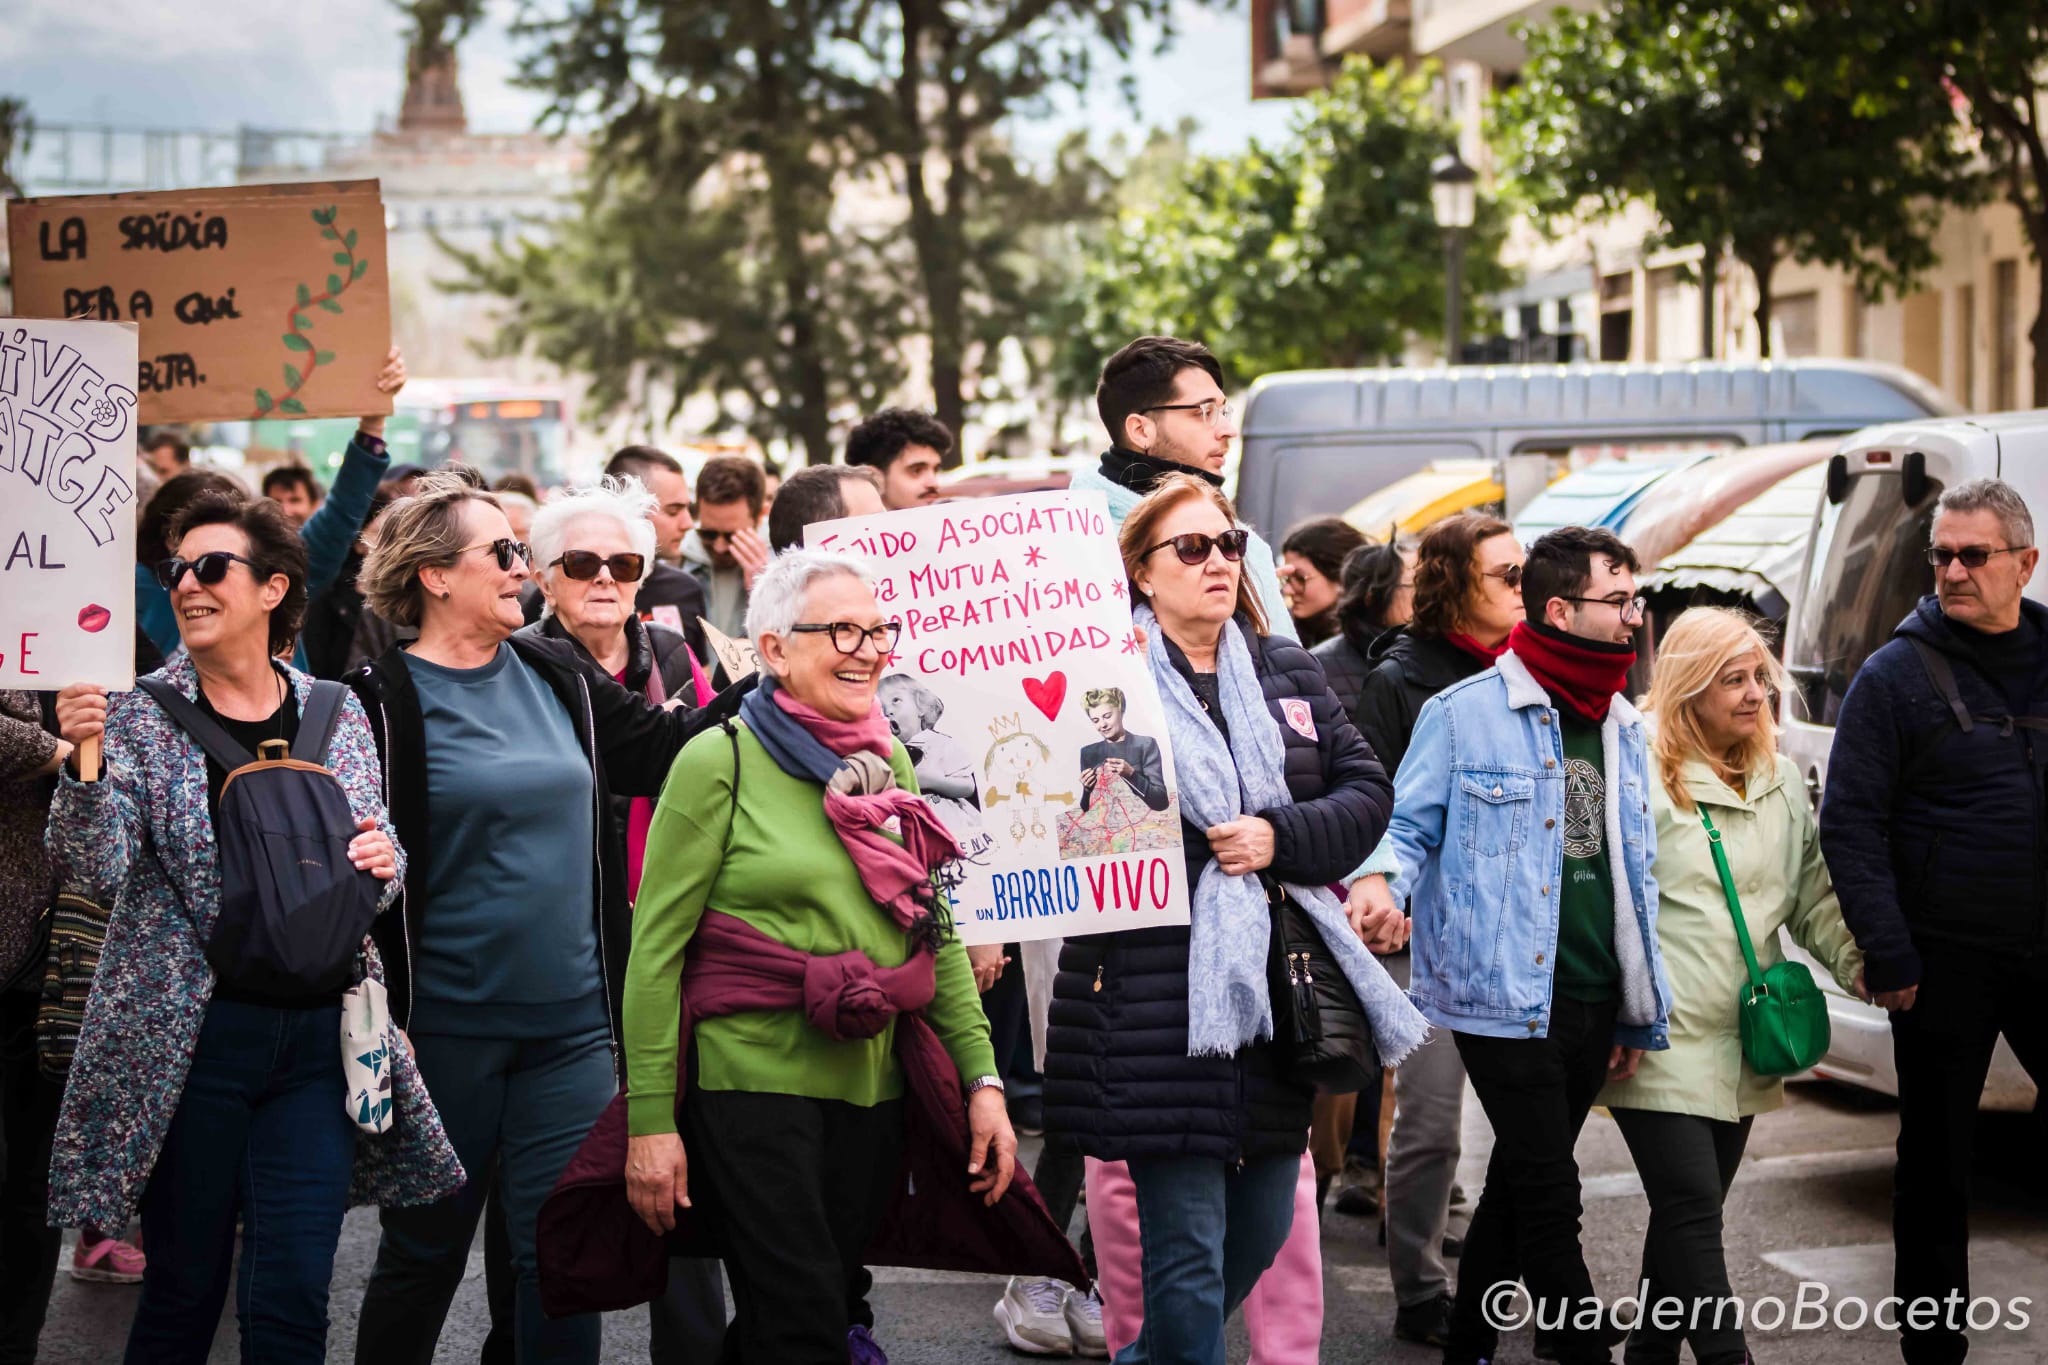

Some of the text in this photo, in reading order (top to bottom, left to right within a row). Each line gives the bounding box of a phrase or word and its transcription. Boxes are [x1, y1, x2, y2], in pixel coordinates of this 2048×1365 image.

[39, 217, 87, 260] LA
[130, 290, 153, 319] A
[5, 531, 66, 571] AL
[909, 558, 1010, 600] MUTUA
[976, 908, 994, 921] UN
[992, 865, 1080, 921] BARRIO
[1085, 857, 1170, 913] VIVO
